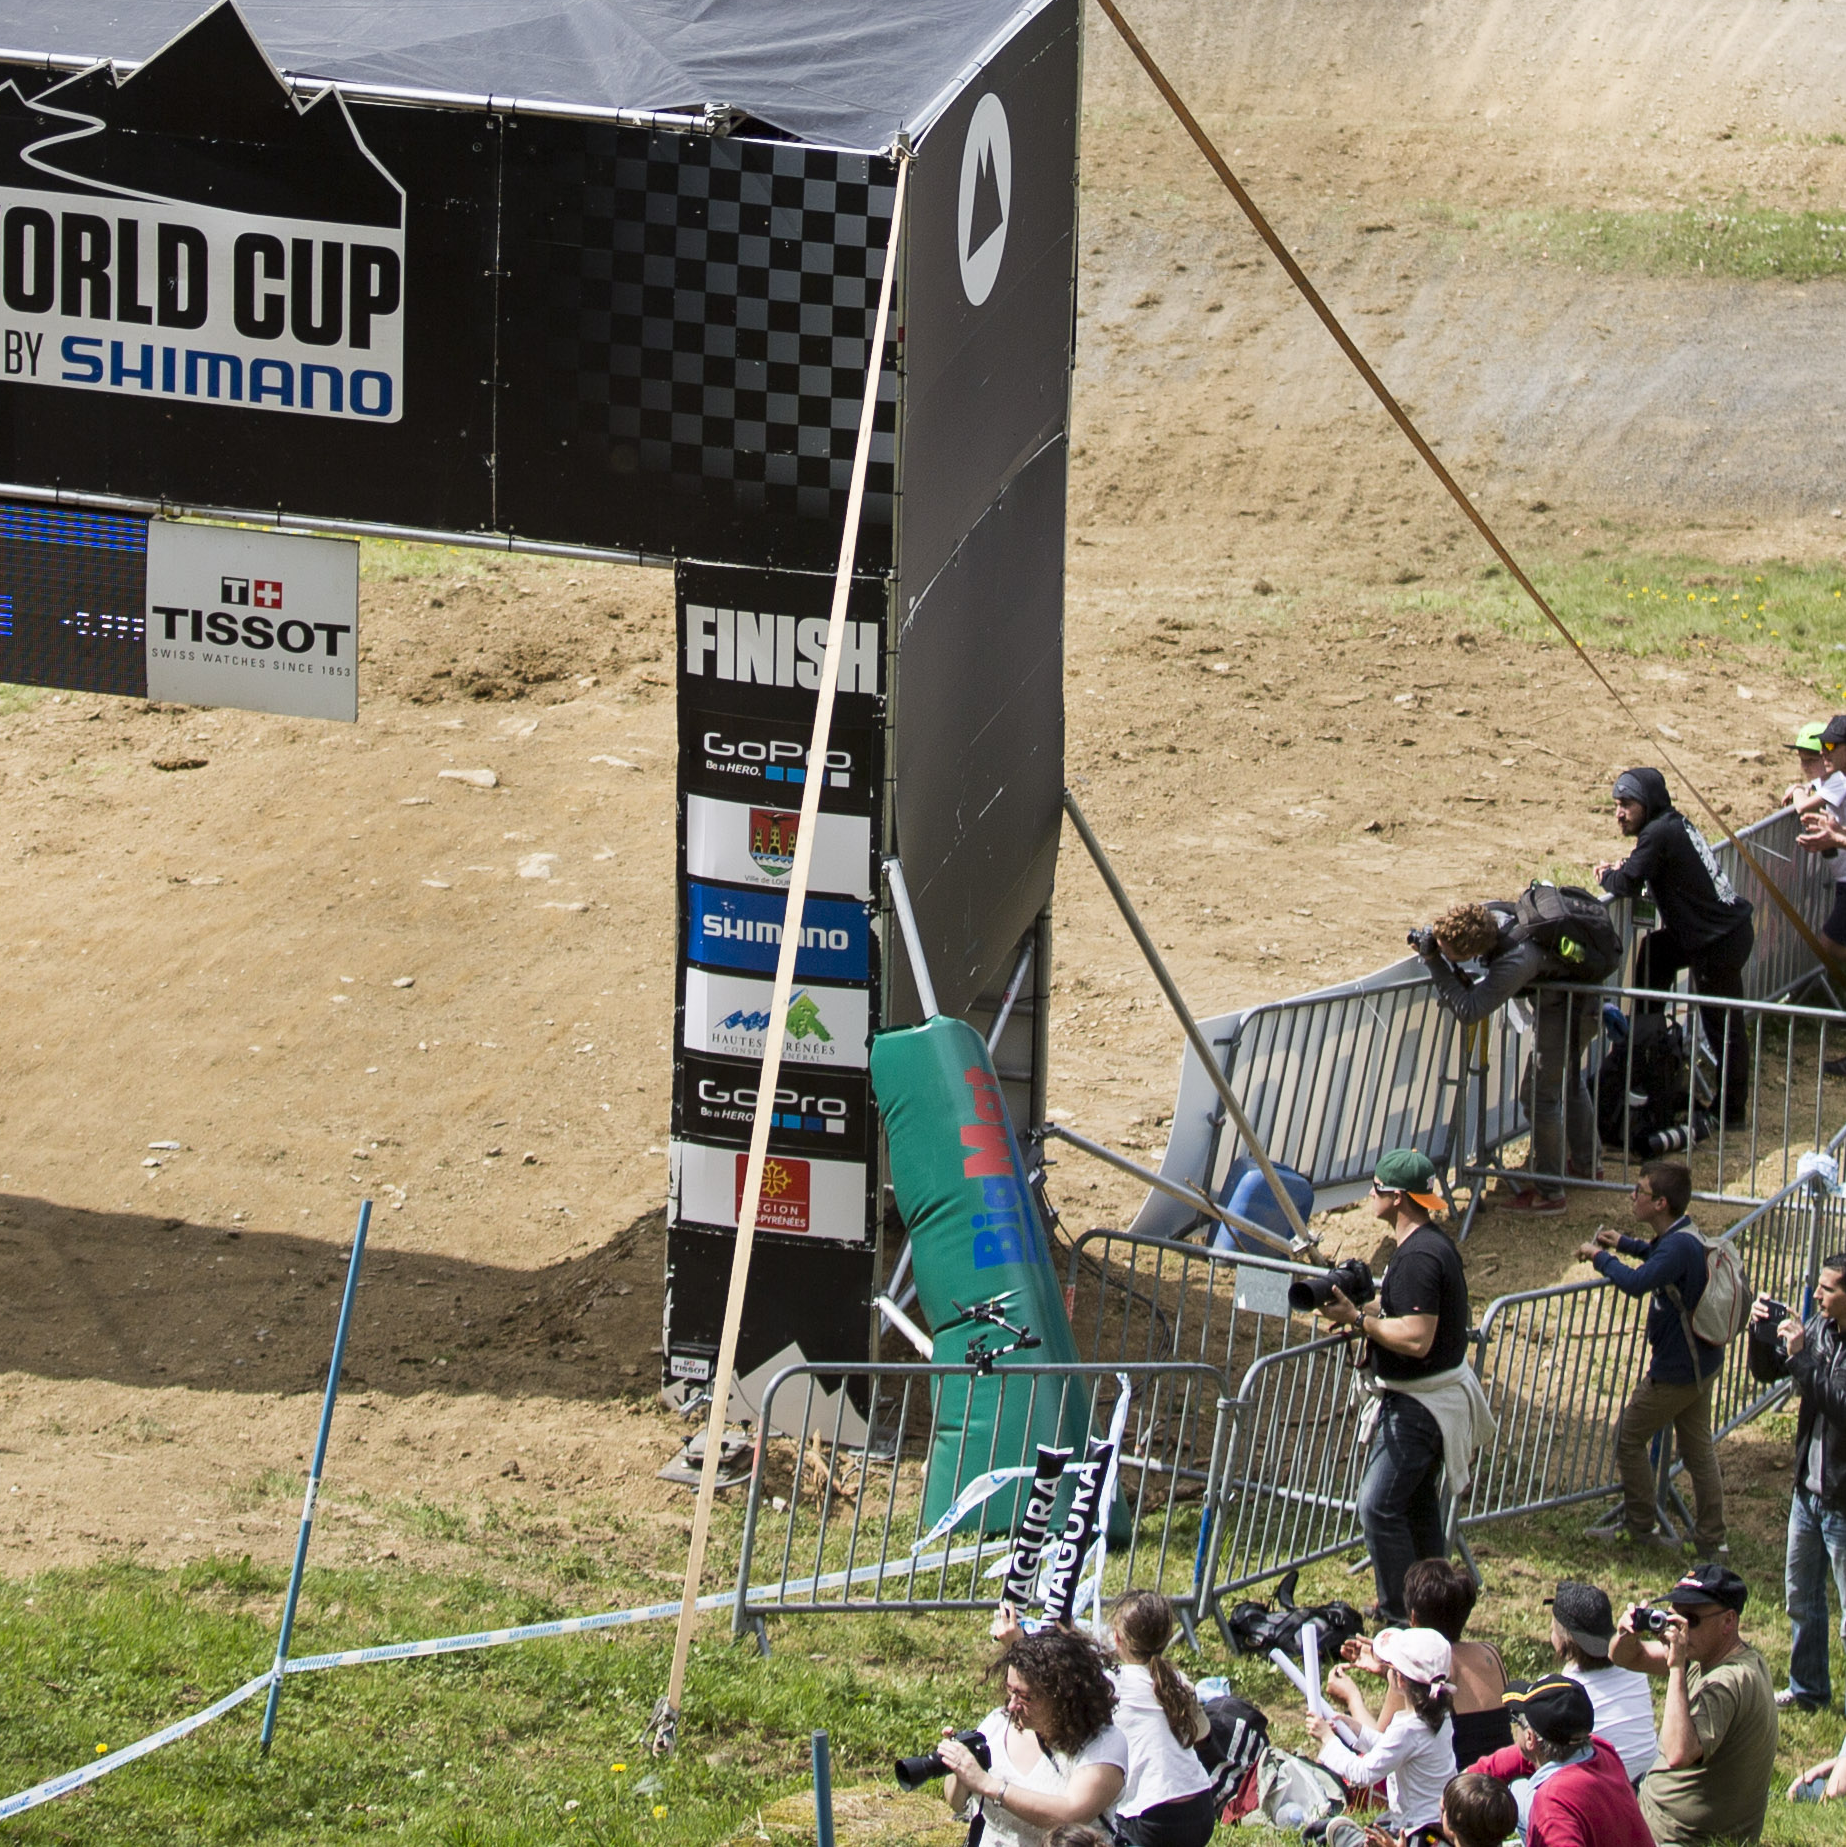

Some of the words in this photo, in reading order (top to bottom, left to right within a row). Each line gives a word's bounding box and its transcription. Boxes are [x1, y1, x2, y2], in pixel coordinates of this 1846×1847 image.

[232, 231, 401, 350] CUP
[3, 326, 44, 377] BY
[61, 334, 393, 418] SHIMANO
[152, 605, 351, 657] TISSOT
[685, 604, 879, 695] FINISH
[151, 647, 195, 661] SWISS
[202, 652, 266, 669] WATCHES
[273, 660, 314, 675] SINCE
[321, 665, 351, 678] 1853
[706, 759, 718, 770] Be
[726, 762, 761, 777] HERO.
[698, 1080, 847, 1117] GoPro
[700, 1107, 713, 1119] Be
[959, 1064, 1025, 1271] BigMat
